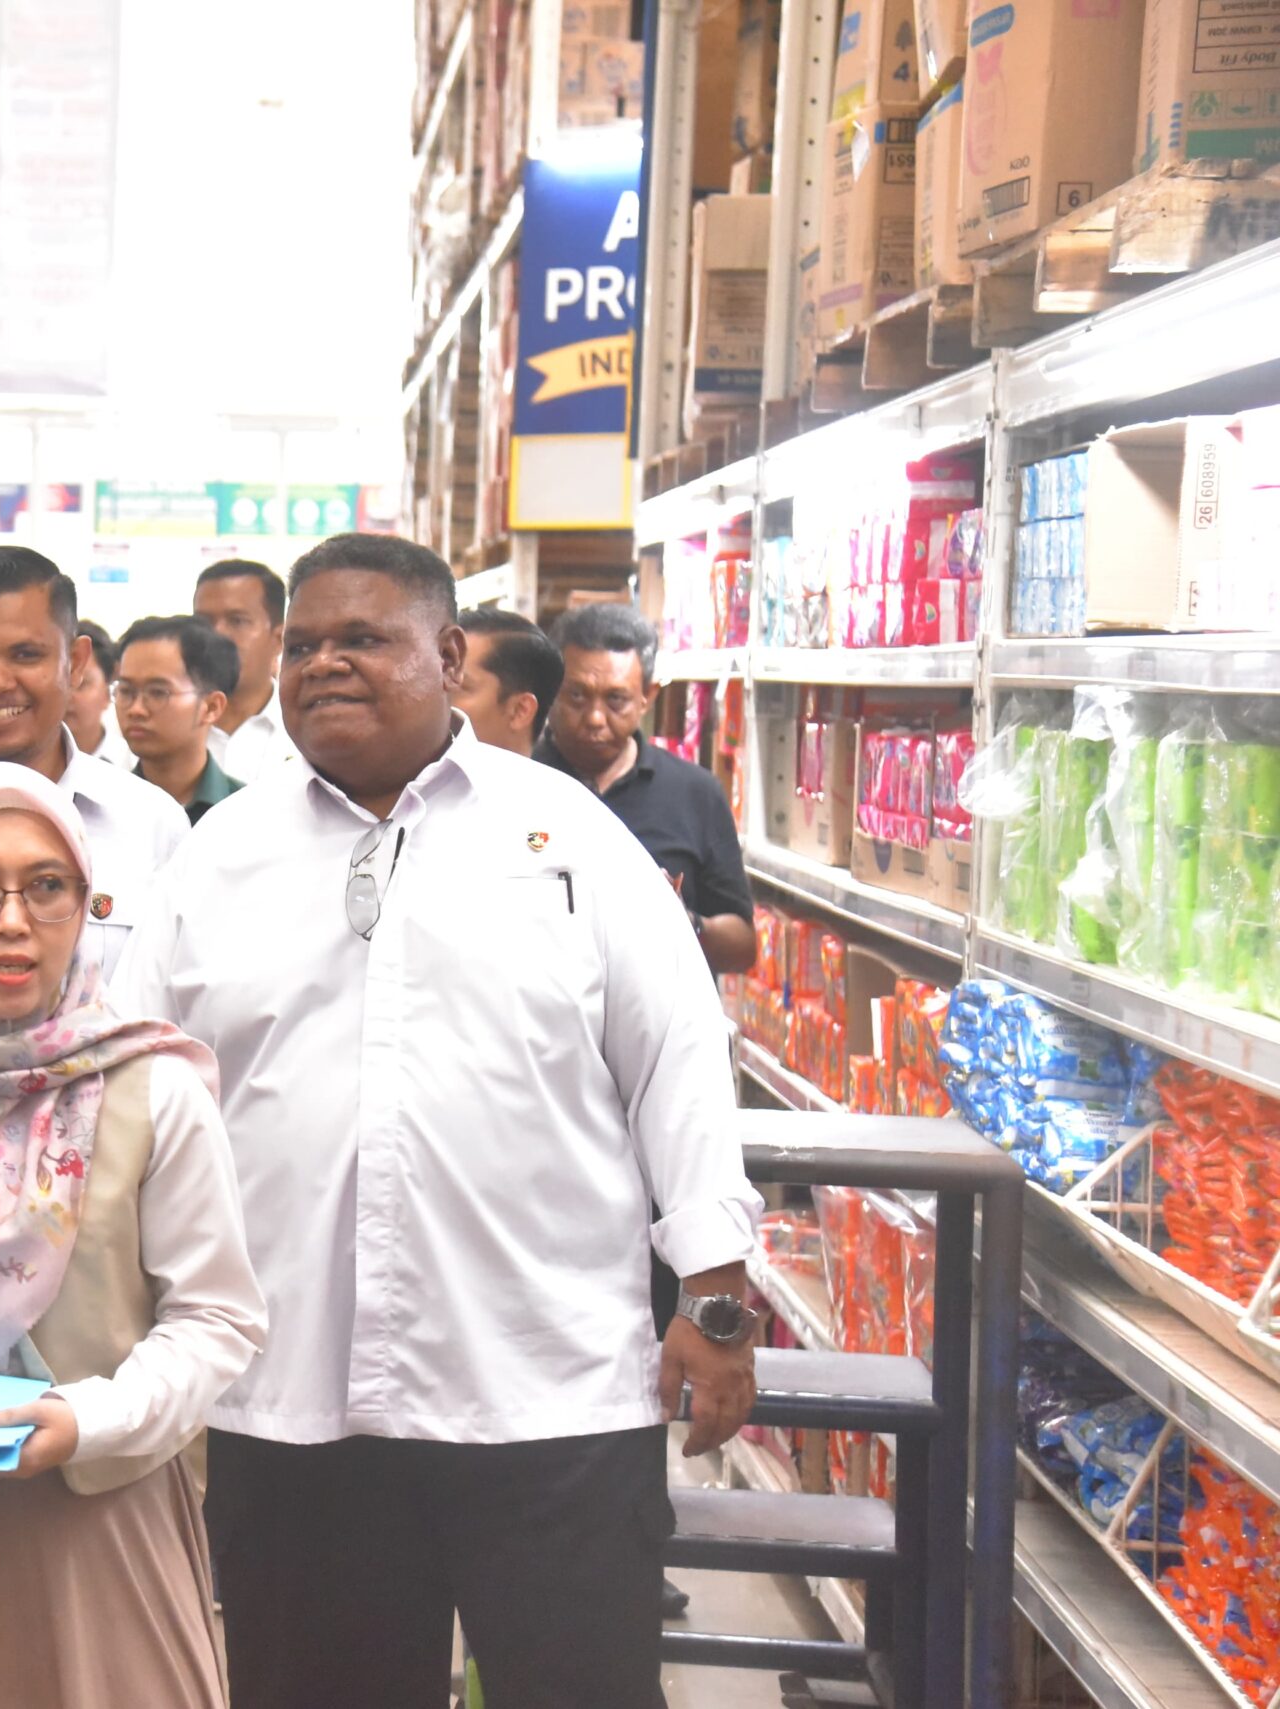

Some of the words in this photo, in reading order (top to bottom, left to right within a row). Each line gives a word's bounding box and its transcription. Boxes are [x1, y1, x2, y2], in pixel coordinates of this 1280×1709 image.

[893, 61, 910, 82] 4
[1068, 190, 1080, 207] 6
[1200, 443, 1217, 498] 608959
[1198, 505, 1213, 525] 26
